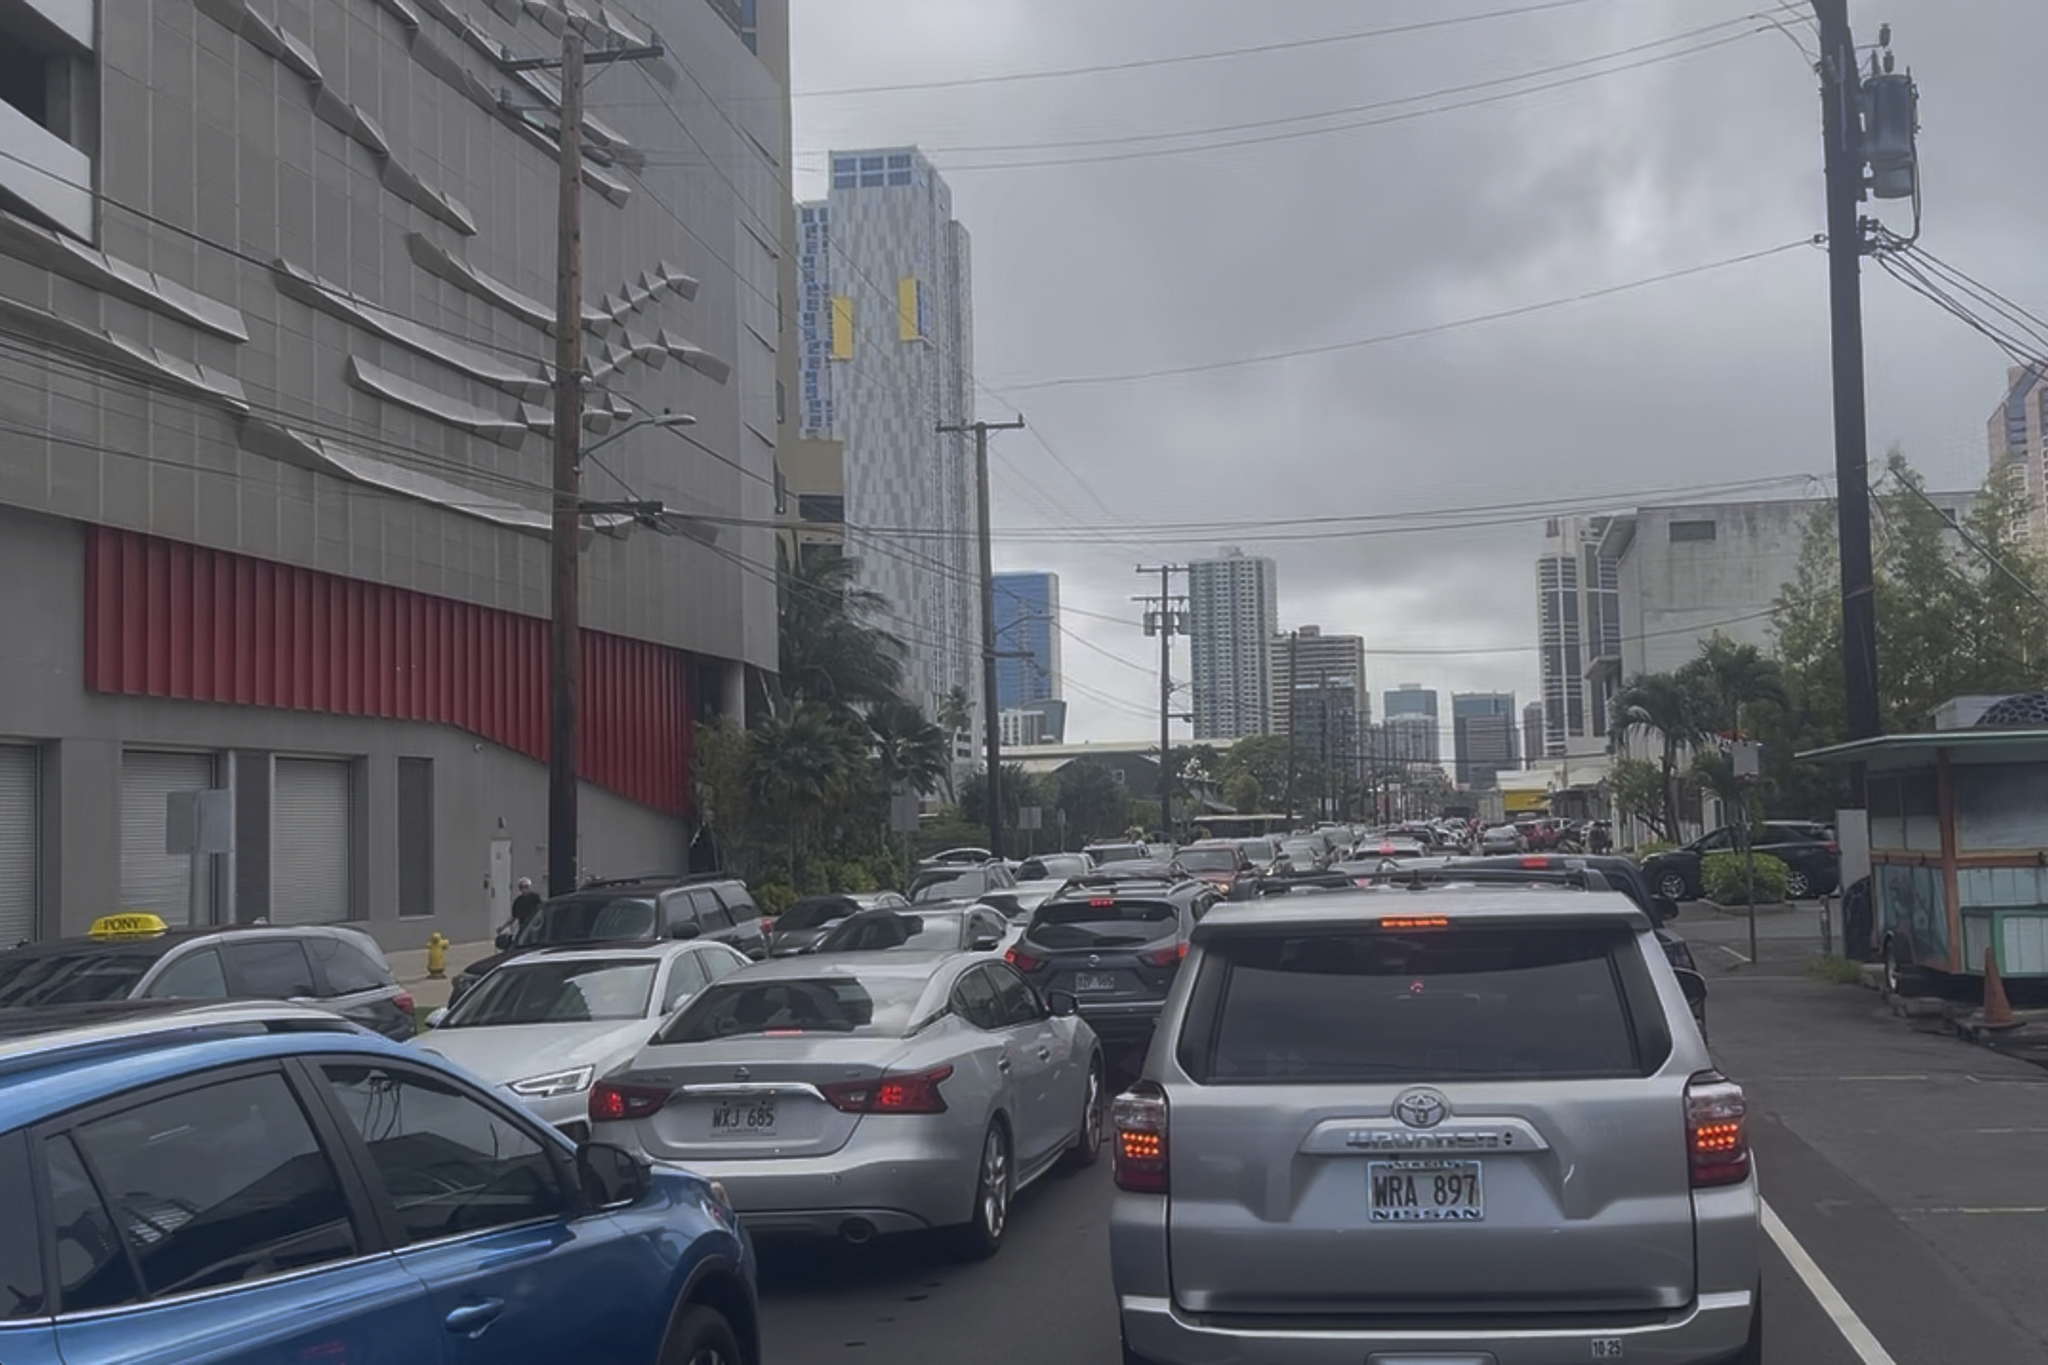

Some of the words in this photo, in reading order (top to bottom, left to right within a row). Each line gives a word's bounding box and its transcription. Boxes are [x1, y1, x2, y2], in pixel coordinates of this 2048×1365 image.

[712, 1109, 740, 1128] WXJ
[749, 1108, 775, 1127] 685
[1374, 1175, 1418, 1207] WRA
[1433, 1174, 1476, 1206] 897
[1373, 1210, 1480, 1219] NISSAN
